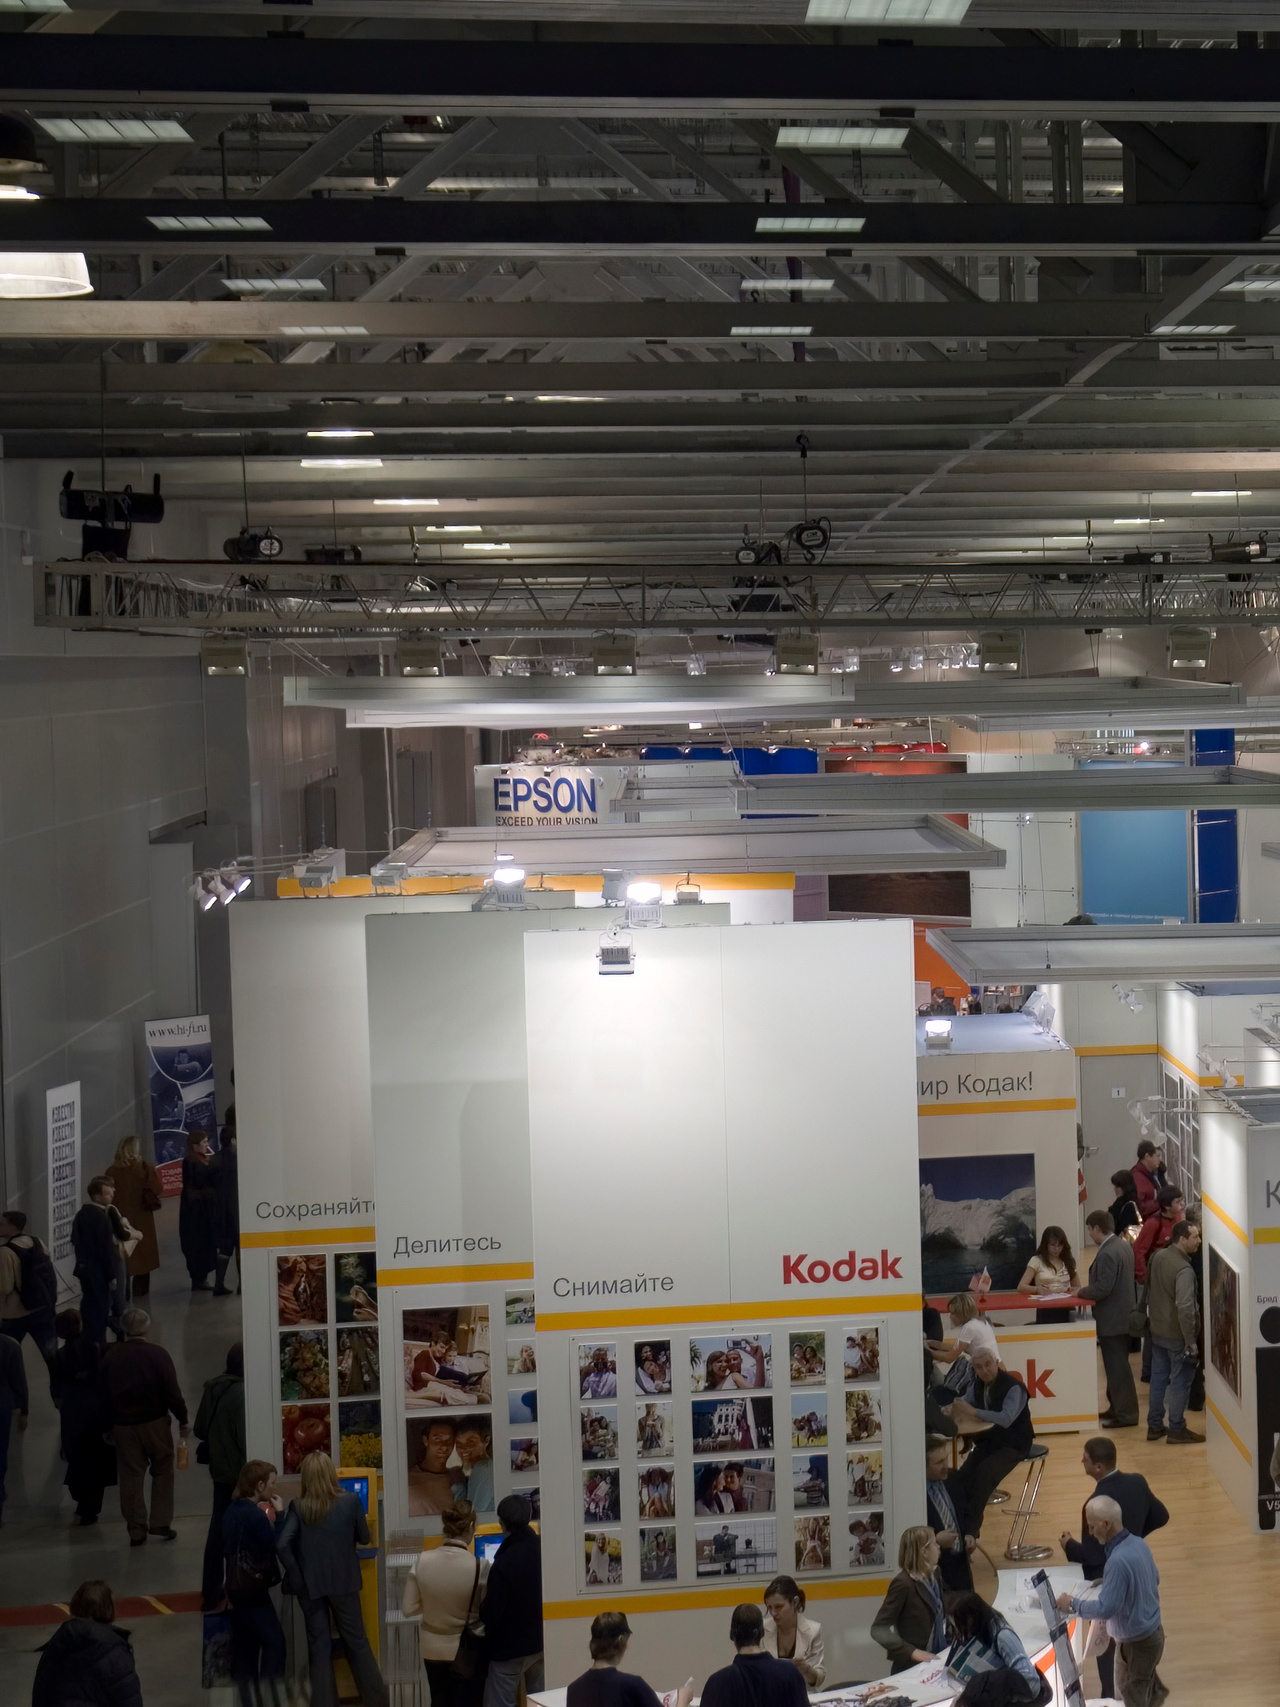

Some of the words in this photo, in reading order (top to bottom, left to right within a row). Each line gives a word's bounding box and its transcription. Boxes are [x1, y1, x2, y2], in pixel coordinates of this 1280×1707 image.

[494, 777, 596, 813] EPSON
[496, 816, 533, 827] EXCEED
[536, 816, 562, 826] YOUR
[565, 816, 598, 825] VISION
[149, 1021, 207, 1037] www.hi-fi.ru
[957, 1071, 1032, 1096] Кодак!
[256, 1197, 375, 1221] Сохраняйт
[394, 1236, 502, 1259] Делитесь
[783, 1249, 903, 1284] Kodak
[553, 1273, 674, 1298] Снимайте
[1256, 1295, 1278, 1304] Бред
